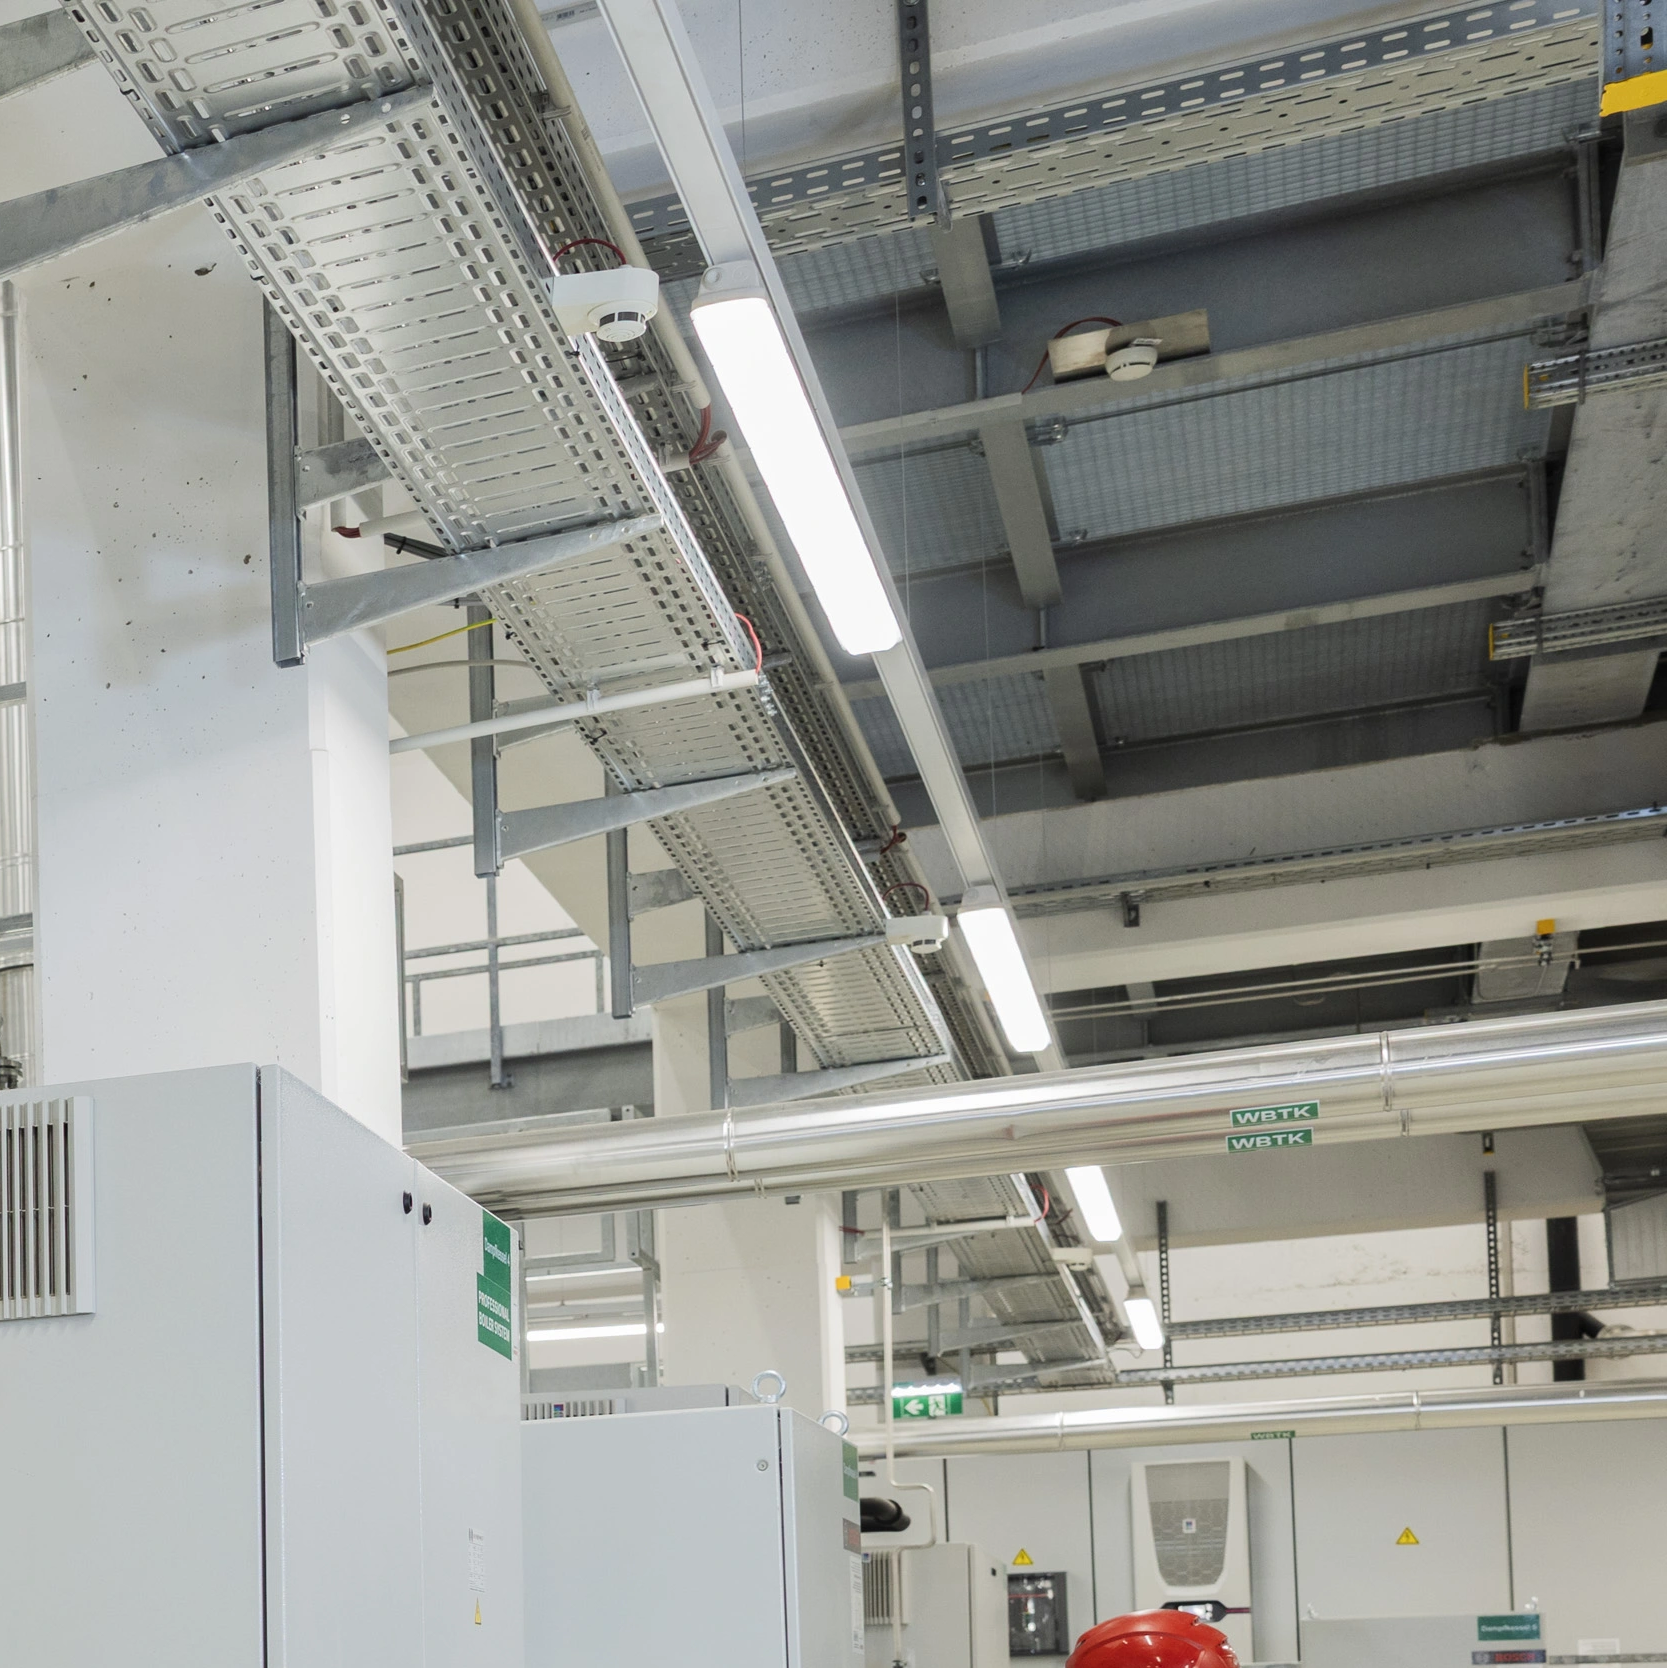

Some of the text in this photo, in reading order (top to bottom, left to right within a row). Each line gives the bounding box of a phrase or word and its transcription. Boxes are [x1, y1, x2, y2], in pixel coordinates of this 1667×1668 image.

[1236, 1105, 1311, 1124] WBTK
[1231, 1132, 1305, 1150] WBTK
[478, 1290, 510, 1322] PROFESSIONAL
[479, 1311, 510, 1342] BOILER SYSTEM
[1494, 1652, 1536, 1663] BOSCH
